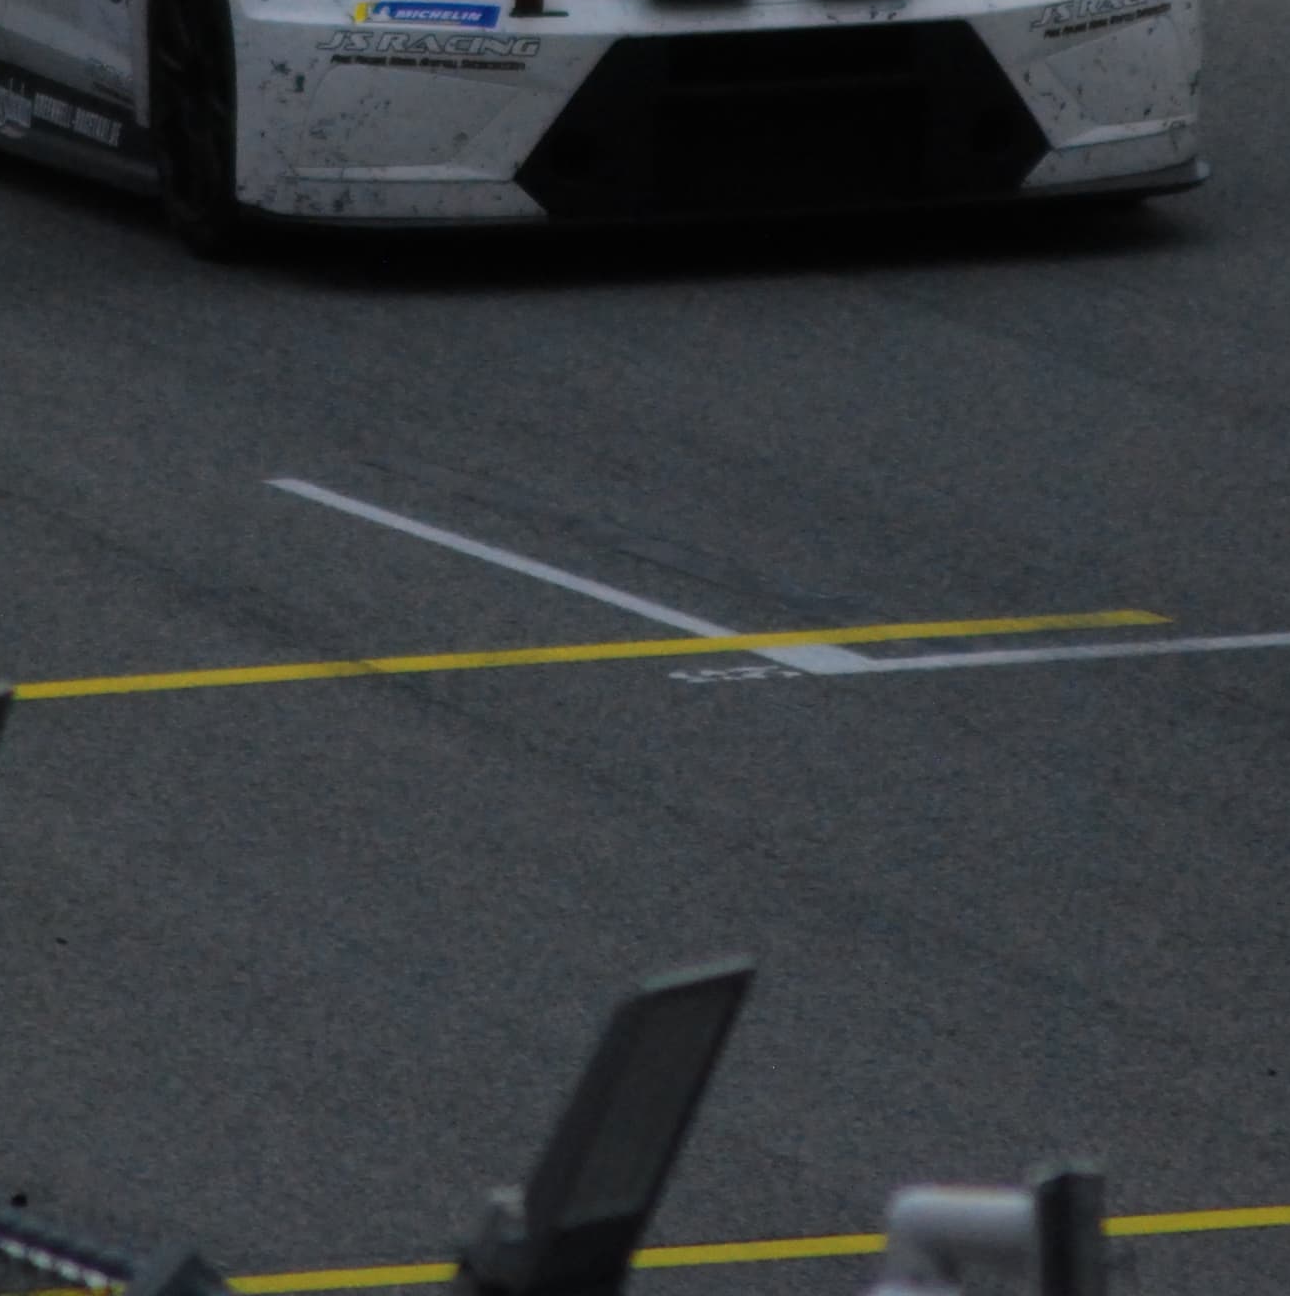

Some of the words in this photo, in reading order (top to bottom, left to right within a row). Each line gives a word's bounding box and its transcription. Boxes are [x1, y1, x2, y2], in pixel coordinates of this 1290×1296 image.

[394, 7, 483, 22] MICHELIN
[315, 30, 374, 55] JS
[372, 31, 542, 57] RACING
